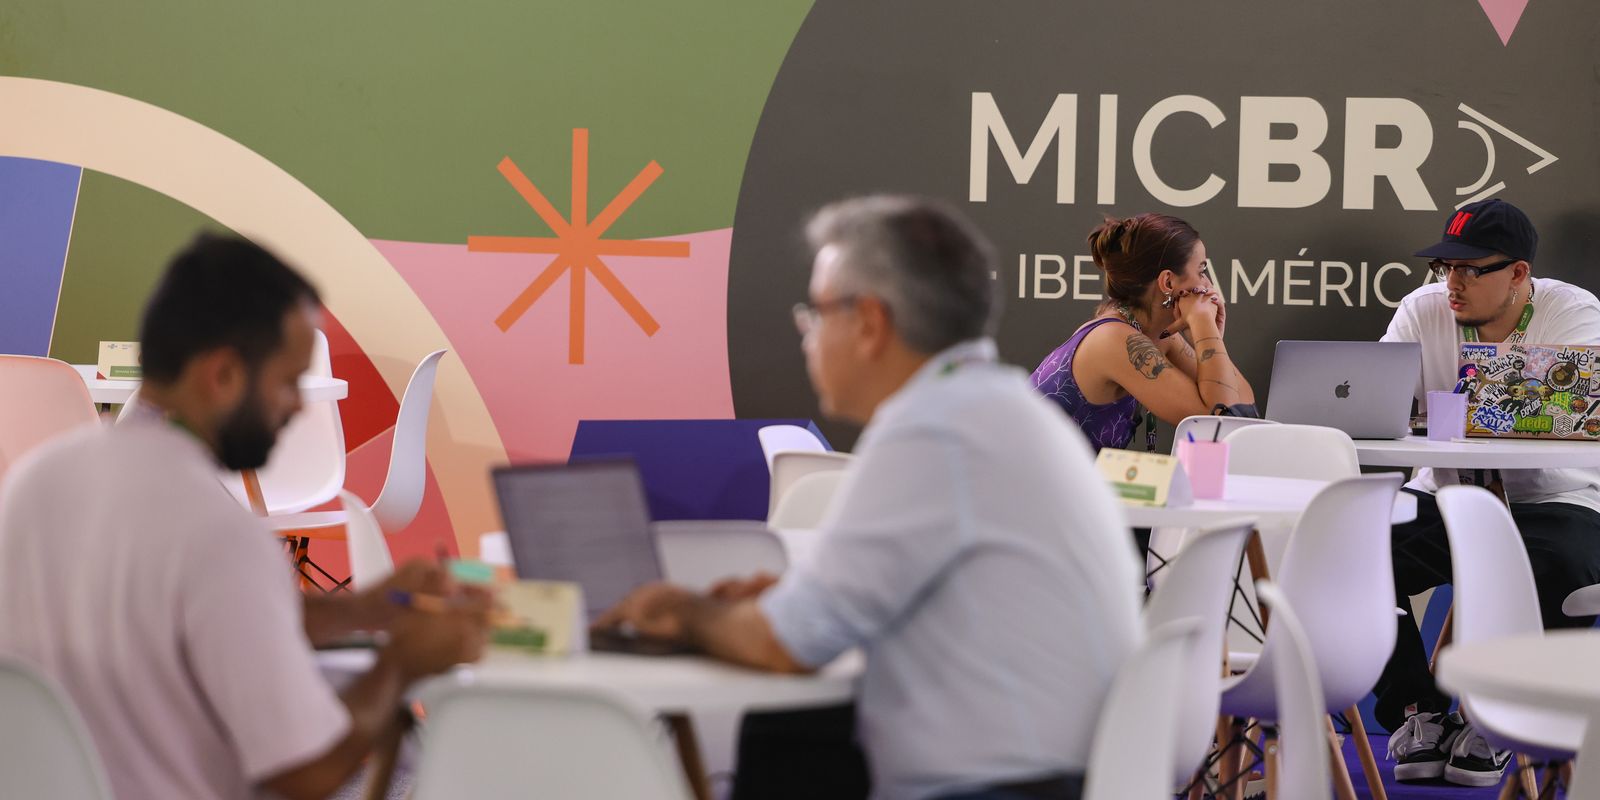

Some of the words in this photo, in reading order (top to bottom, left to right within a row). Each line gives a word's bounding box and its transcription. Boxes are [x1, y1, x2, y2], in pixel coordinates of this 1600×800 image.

[969, 91, 1439, 212] MICBR
[1446, 211, 1473, 237] M
[1018, 248, 1444, 309] IBEMÉRIC
